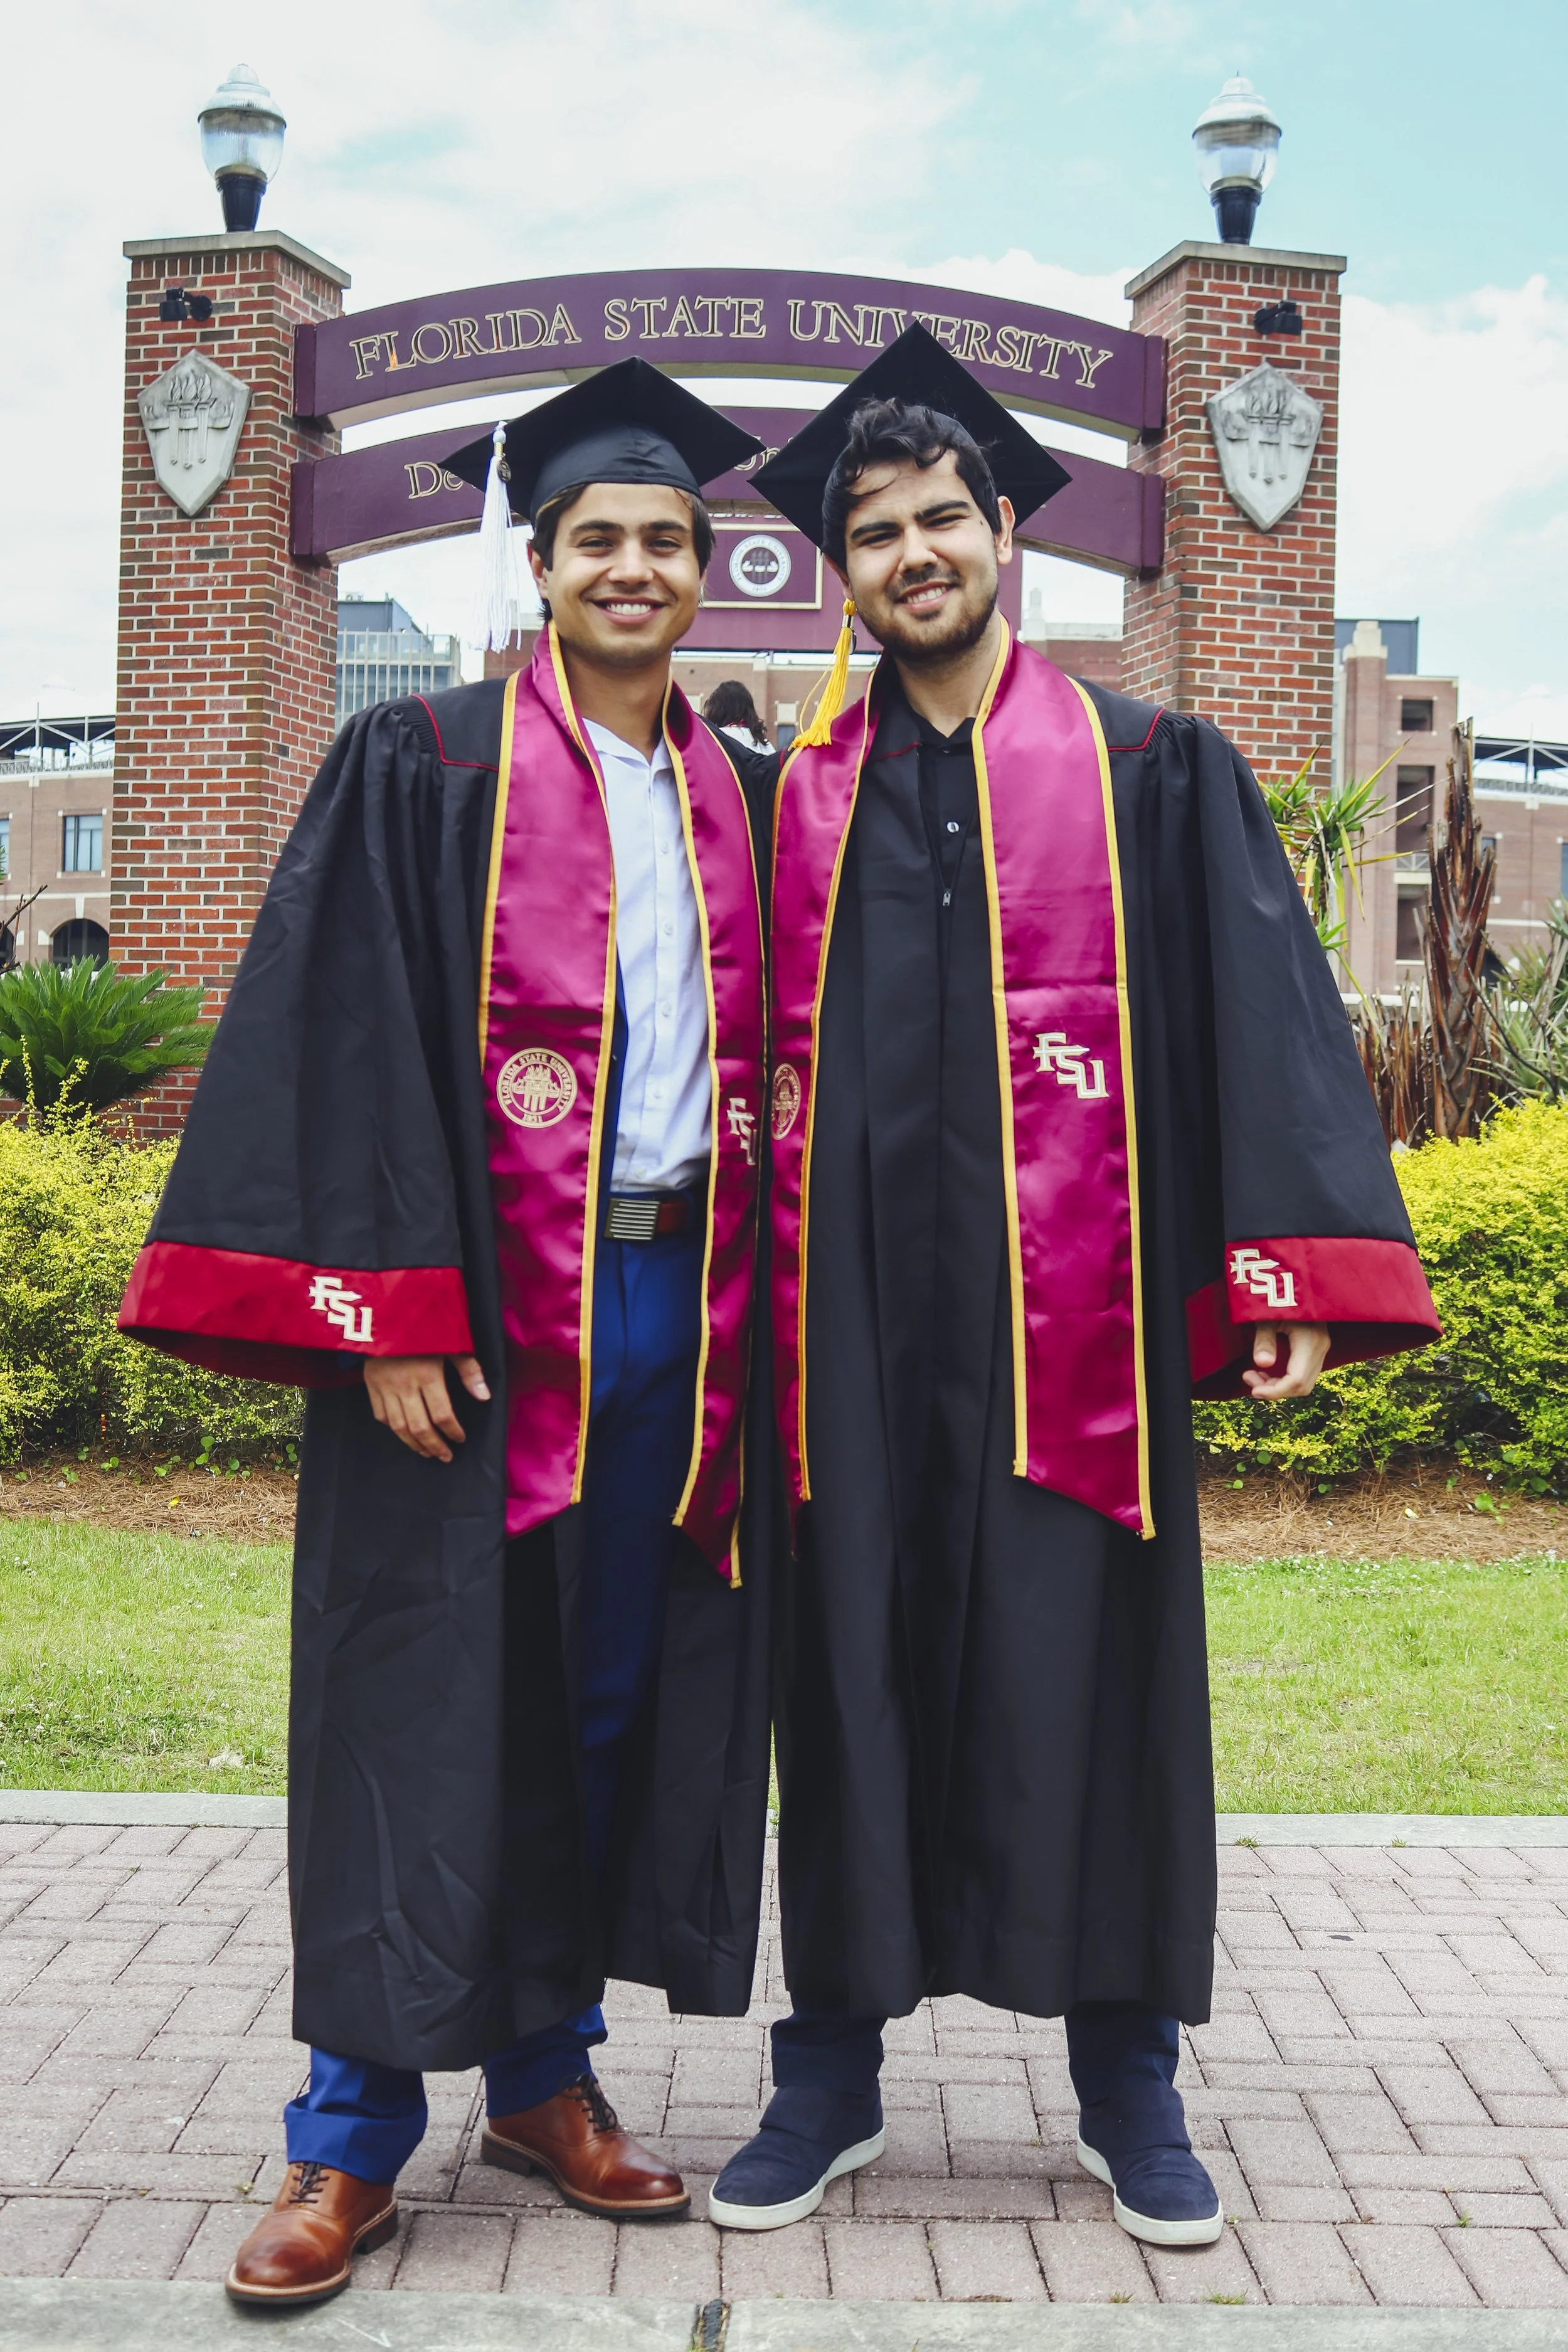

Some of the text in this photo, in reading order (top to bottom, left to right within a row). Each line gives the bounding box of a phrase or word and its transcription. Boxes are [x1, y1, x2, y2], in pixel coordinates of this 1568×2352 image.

[349, 296, 1113, 388] FLORIDA STATE UNIVERSITY
[519, 1052, 548, 1066] STATE
[1032, 1032, 1110, 1099] FSU
[308, 1276, 374, 1342] FSU
[1229, 1248, 1298, 1307] FSU
